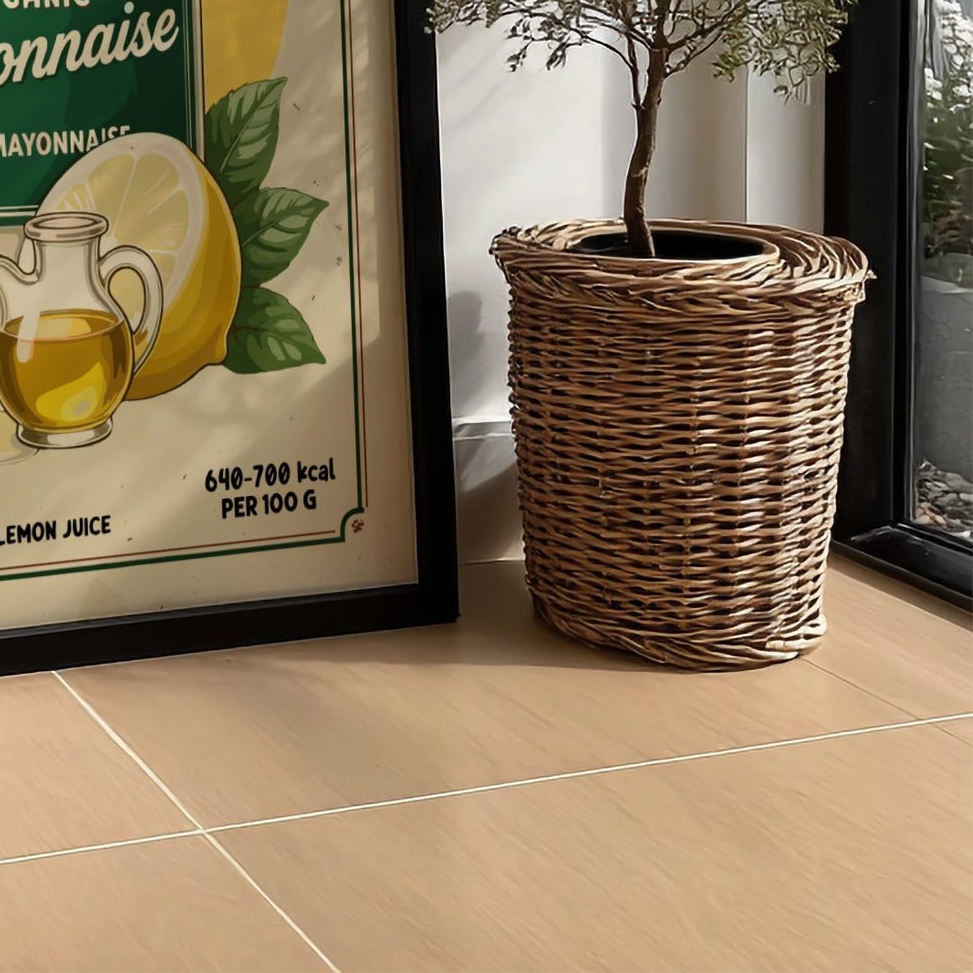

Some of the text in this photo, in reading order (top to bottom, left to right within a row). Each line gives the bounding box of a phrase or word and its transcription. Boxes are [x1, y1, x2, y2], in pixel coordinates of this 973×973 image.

[205, 457, 336, 493] 640-700 kcal
[221, 489, 317, 519] PER 100 G
[62, 515, 112, 539] JUICE
